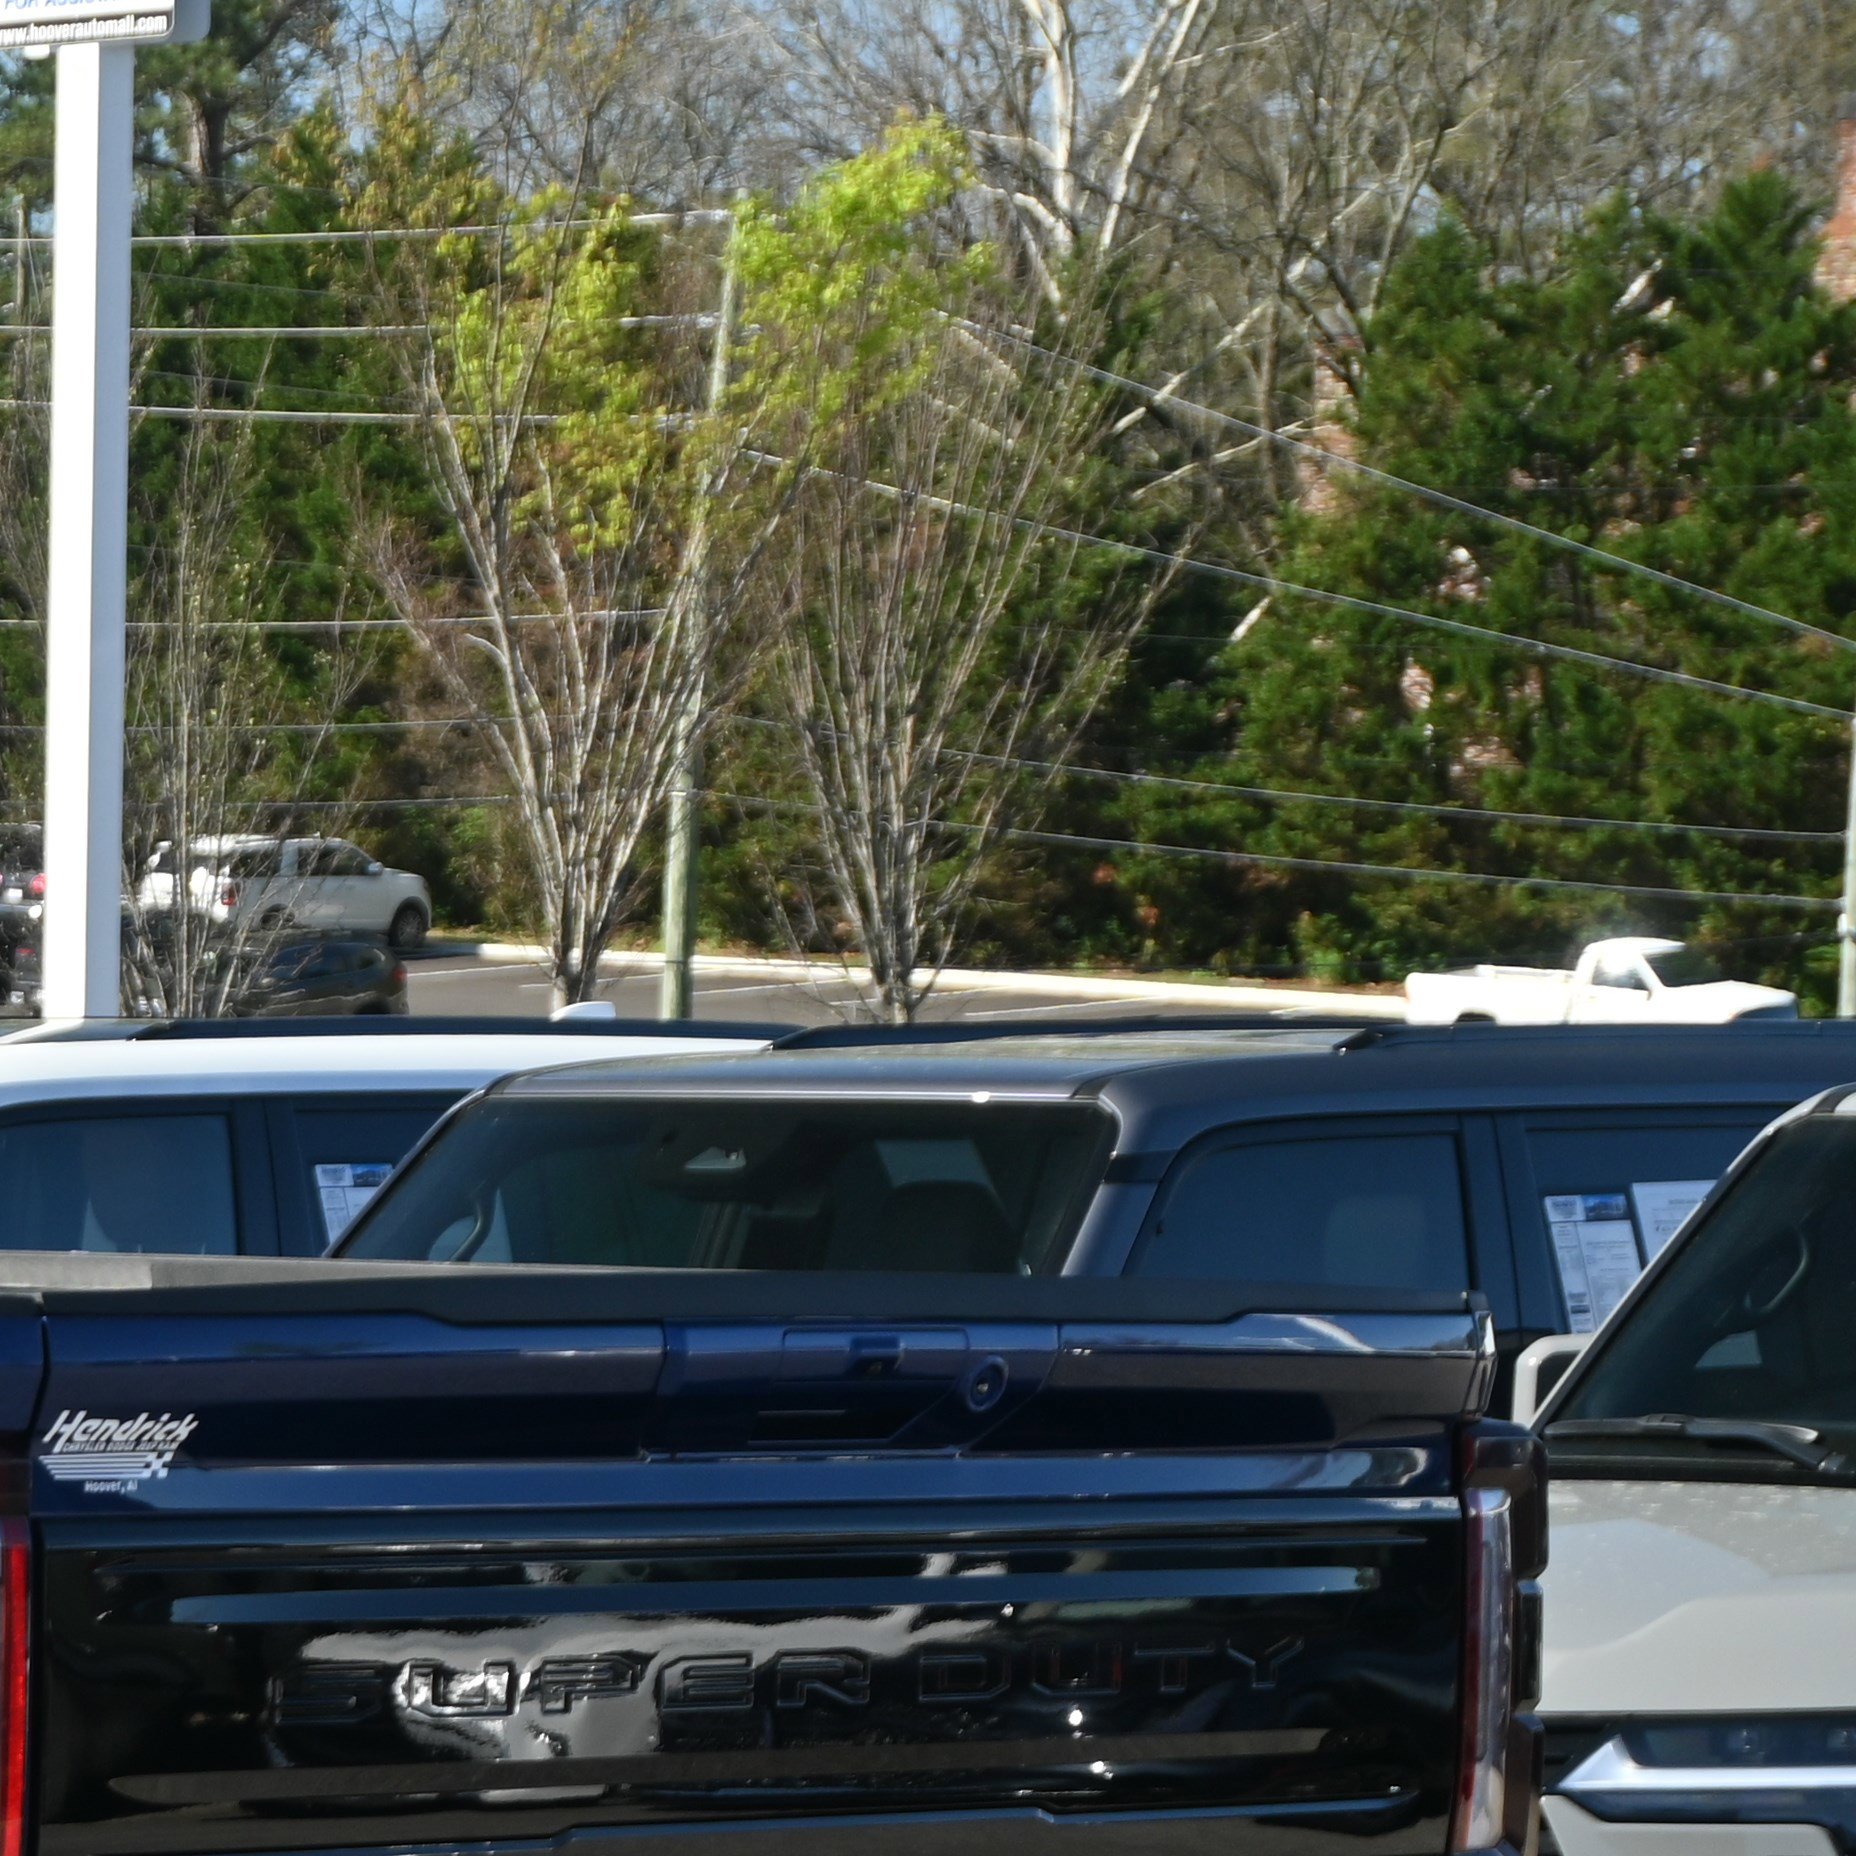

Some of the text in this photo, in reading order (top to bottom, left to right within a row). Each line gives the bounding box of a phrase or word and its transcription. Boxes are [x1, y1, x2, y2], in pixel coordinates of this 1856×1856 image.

[42, 1410, 199, 1453] Hendrick
[273, 1635, 1305, 1725] SUPER DUTY
